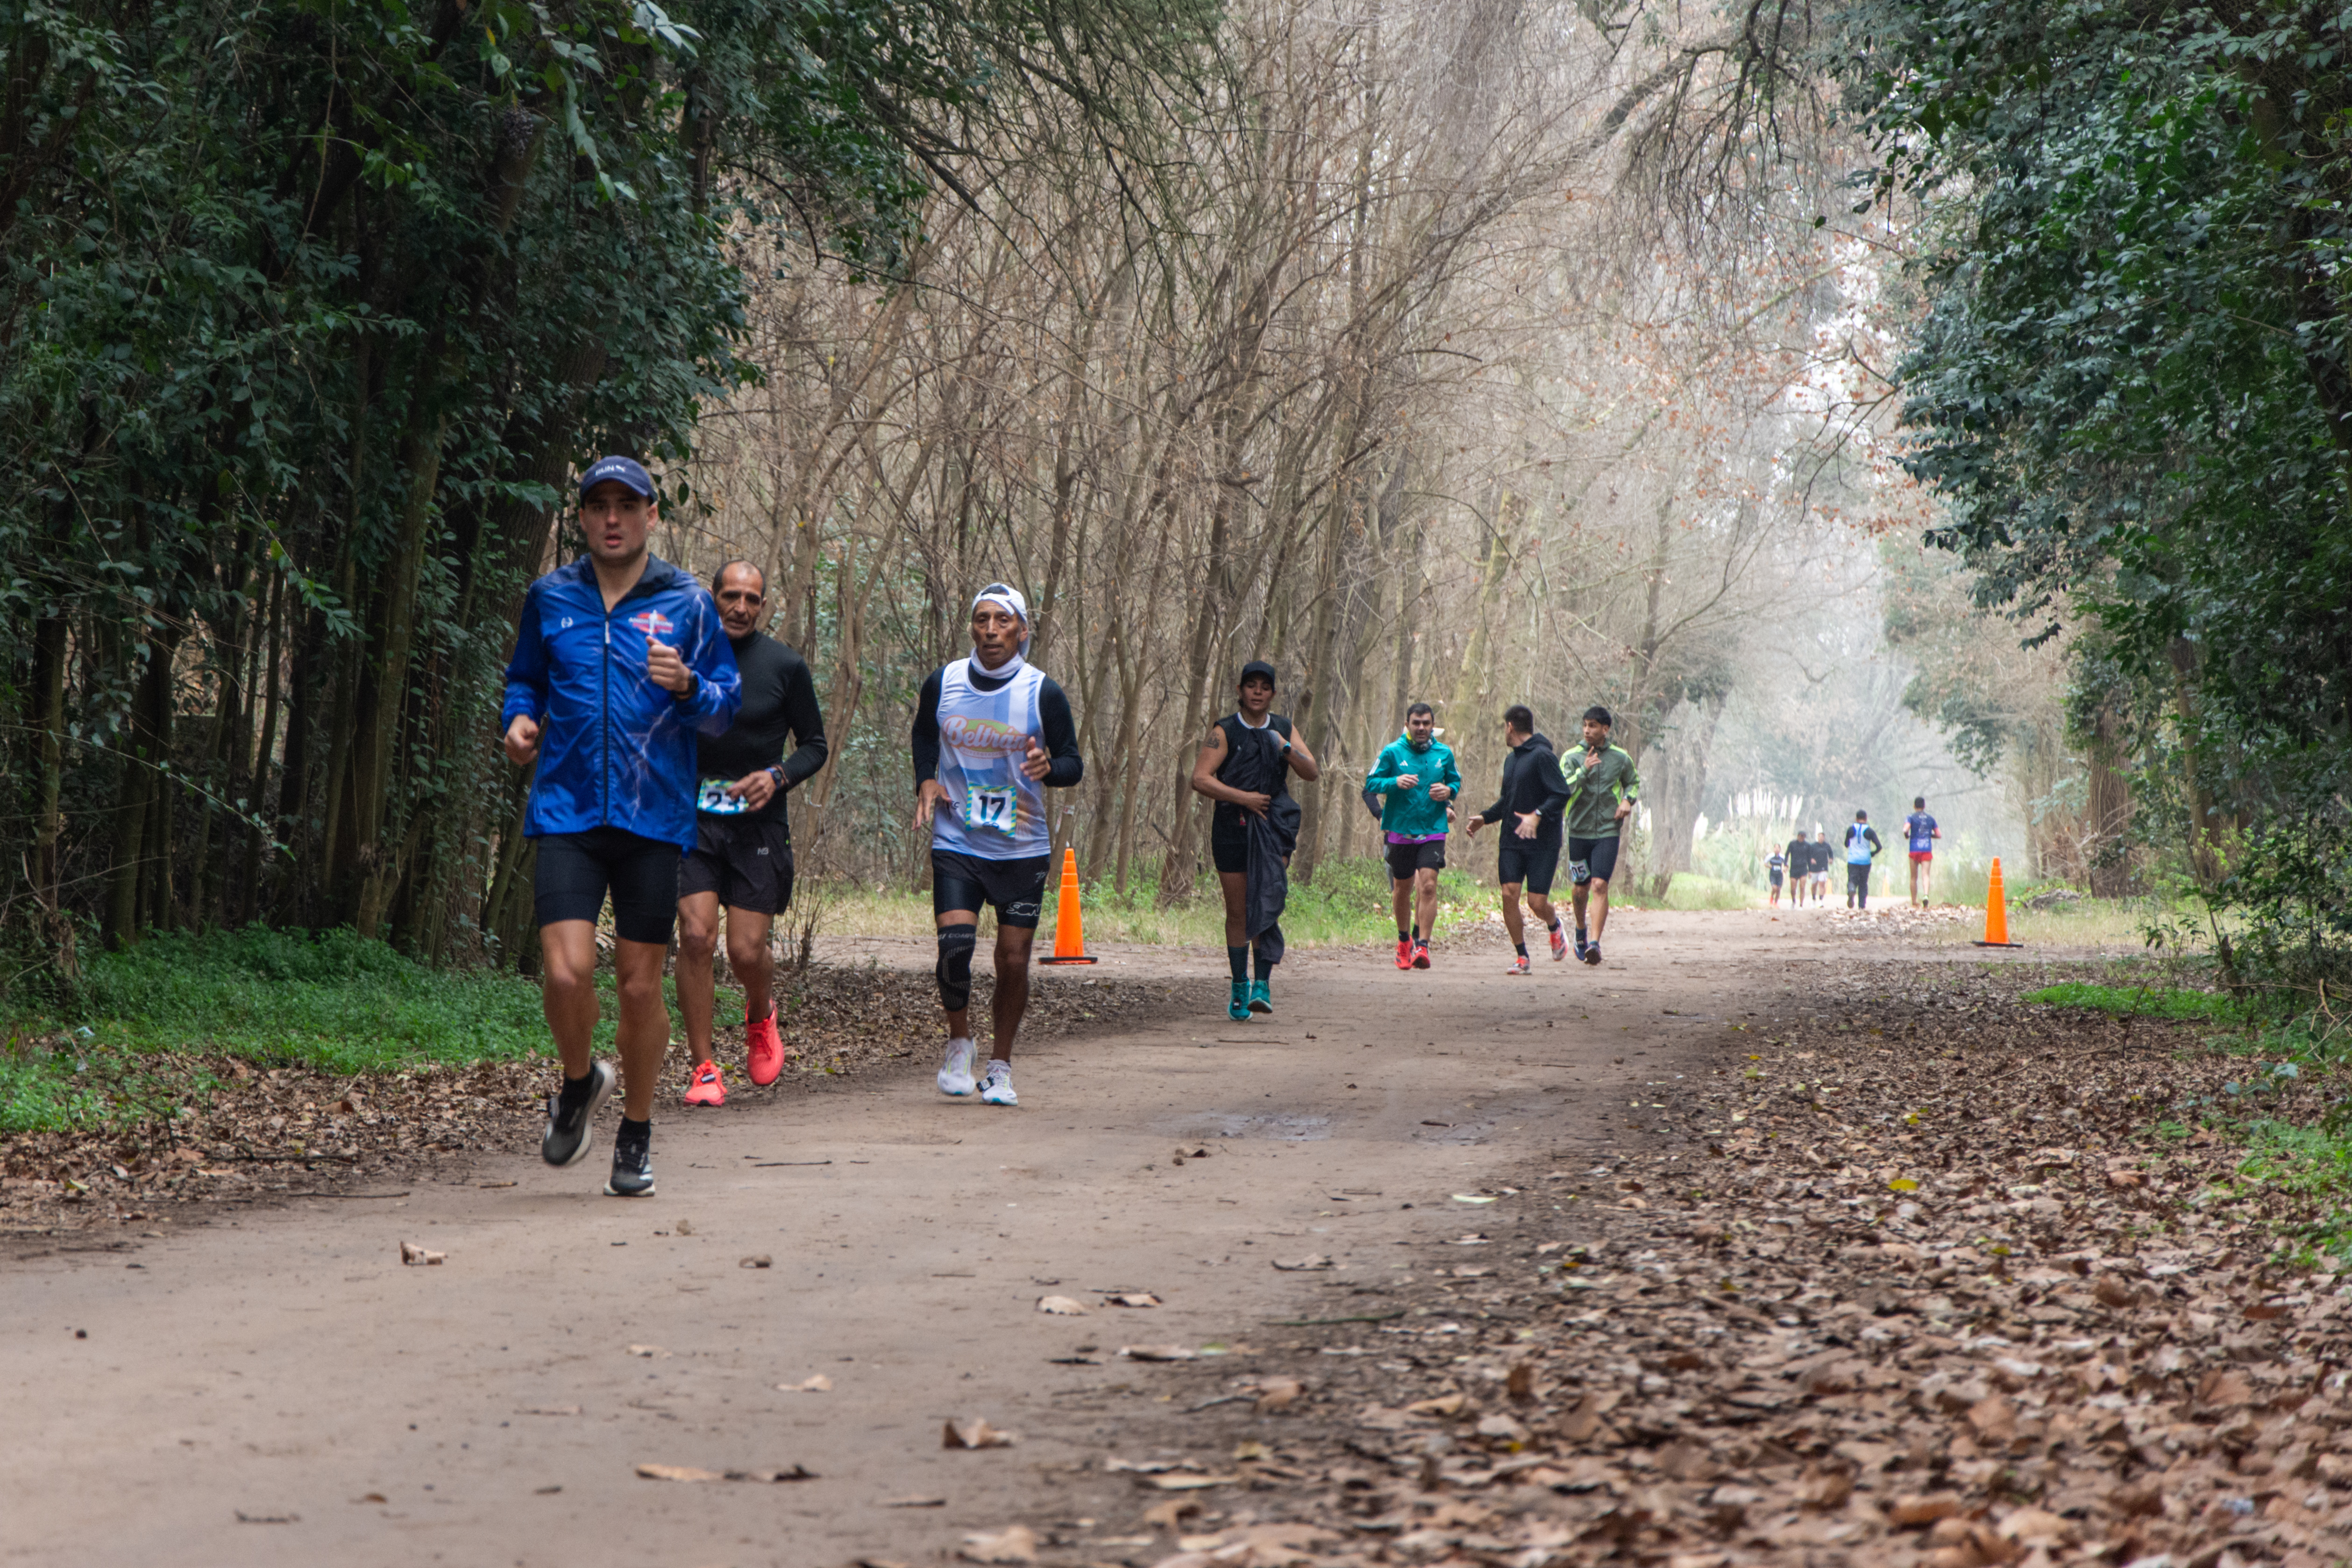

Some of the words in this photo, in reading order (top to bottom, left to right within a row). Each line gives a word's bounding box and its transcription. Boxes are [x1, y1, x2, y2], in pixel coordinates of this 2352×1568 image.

[595, 465, 615, 476] RUN
[943, 716, 1027, 749] Beltrán
[979, 795, 1006, 822] 17
